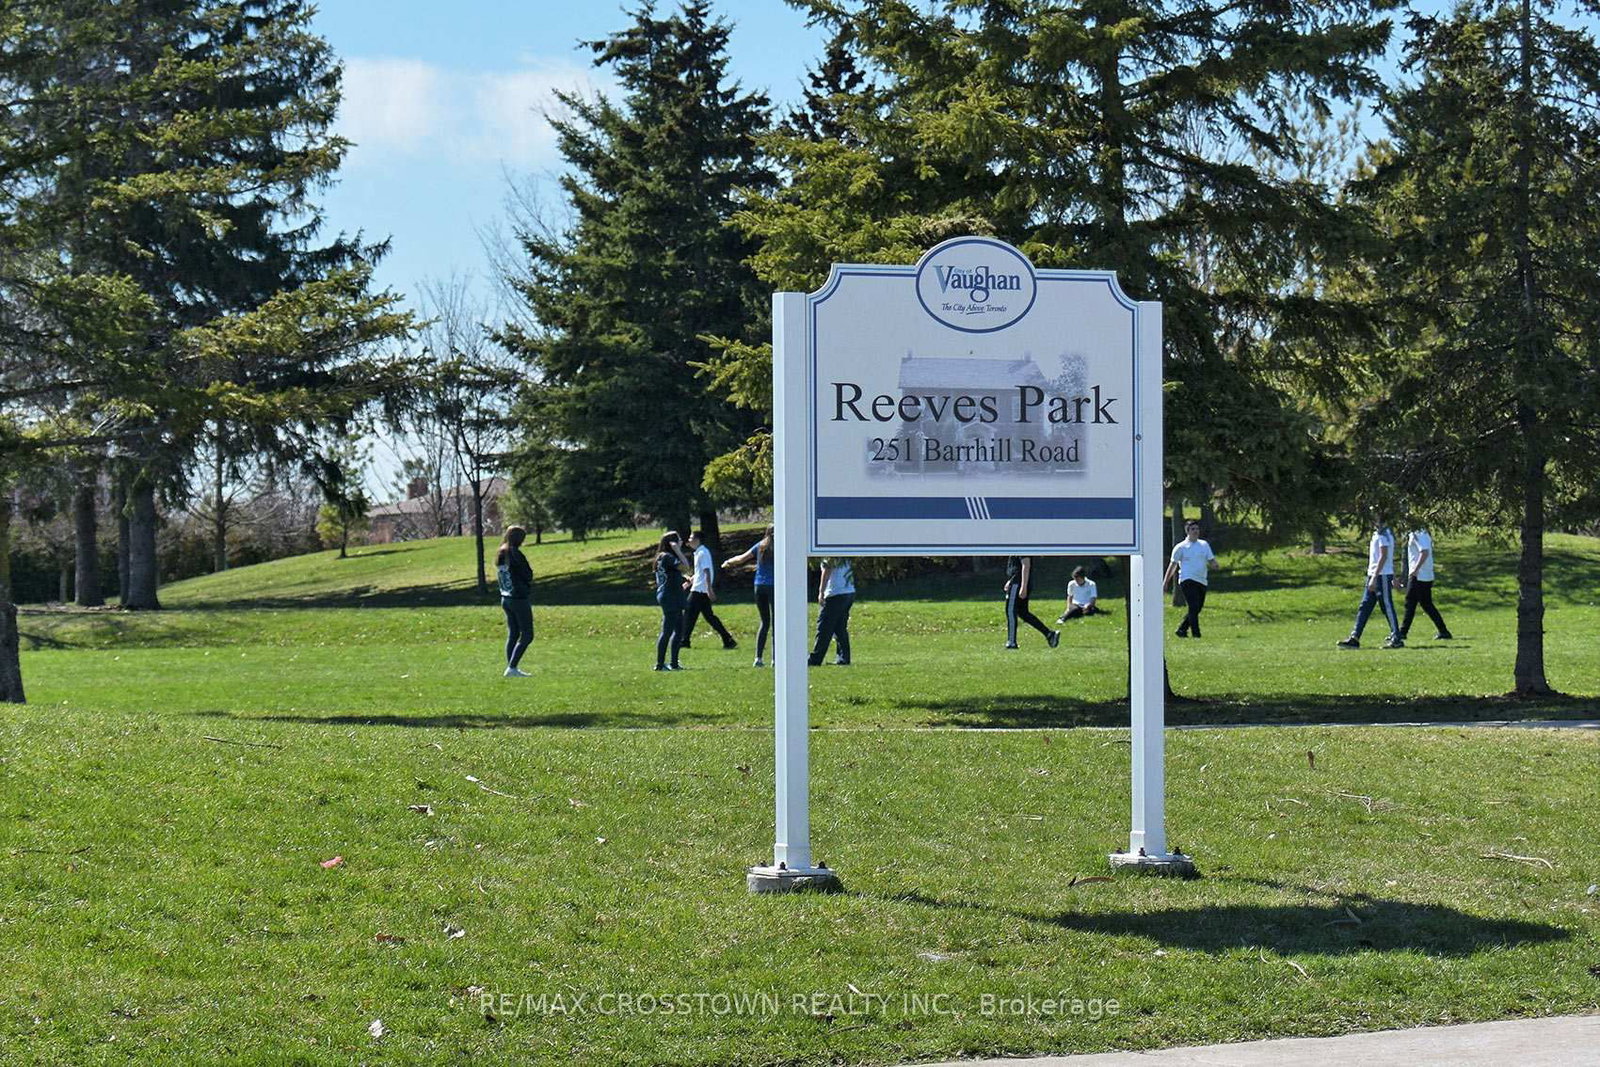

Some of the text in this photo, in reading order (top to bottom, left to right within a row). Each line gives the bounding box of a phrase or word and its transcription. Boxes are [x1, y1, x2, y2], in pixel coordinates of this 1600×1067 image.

[933, 265, 1022, 303] Vaughan
[942, 303, 1007, 313] The City Above Toronto
[831, 382, 1119, 425] Reeves Park
[872, 437, 1080, 463] 251 Barrhill Road
